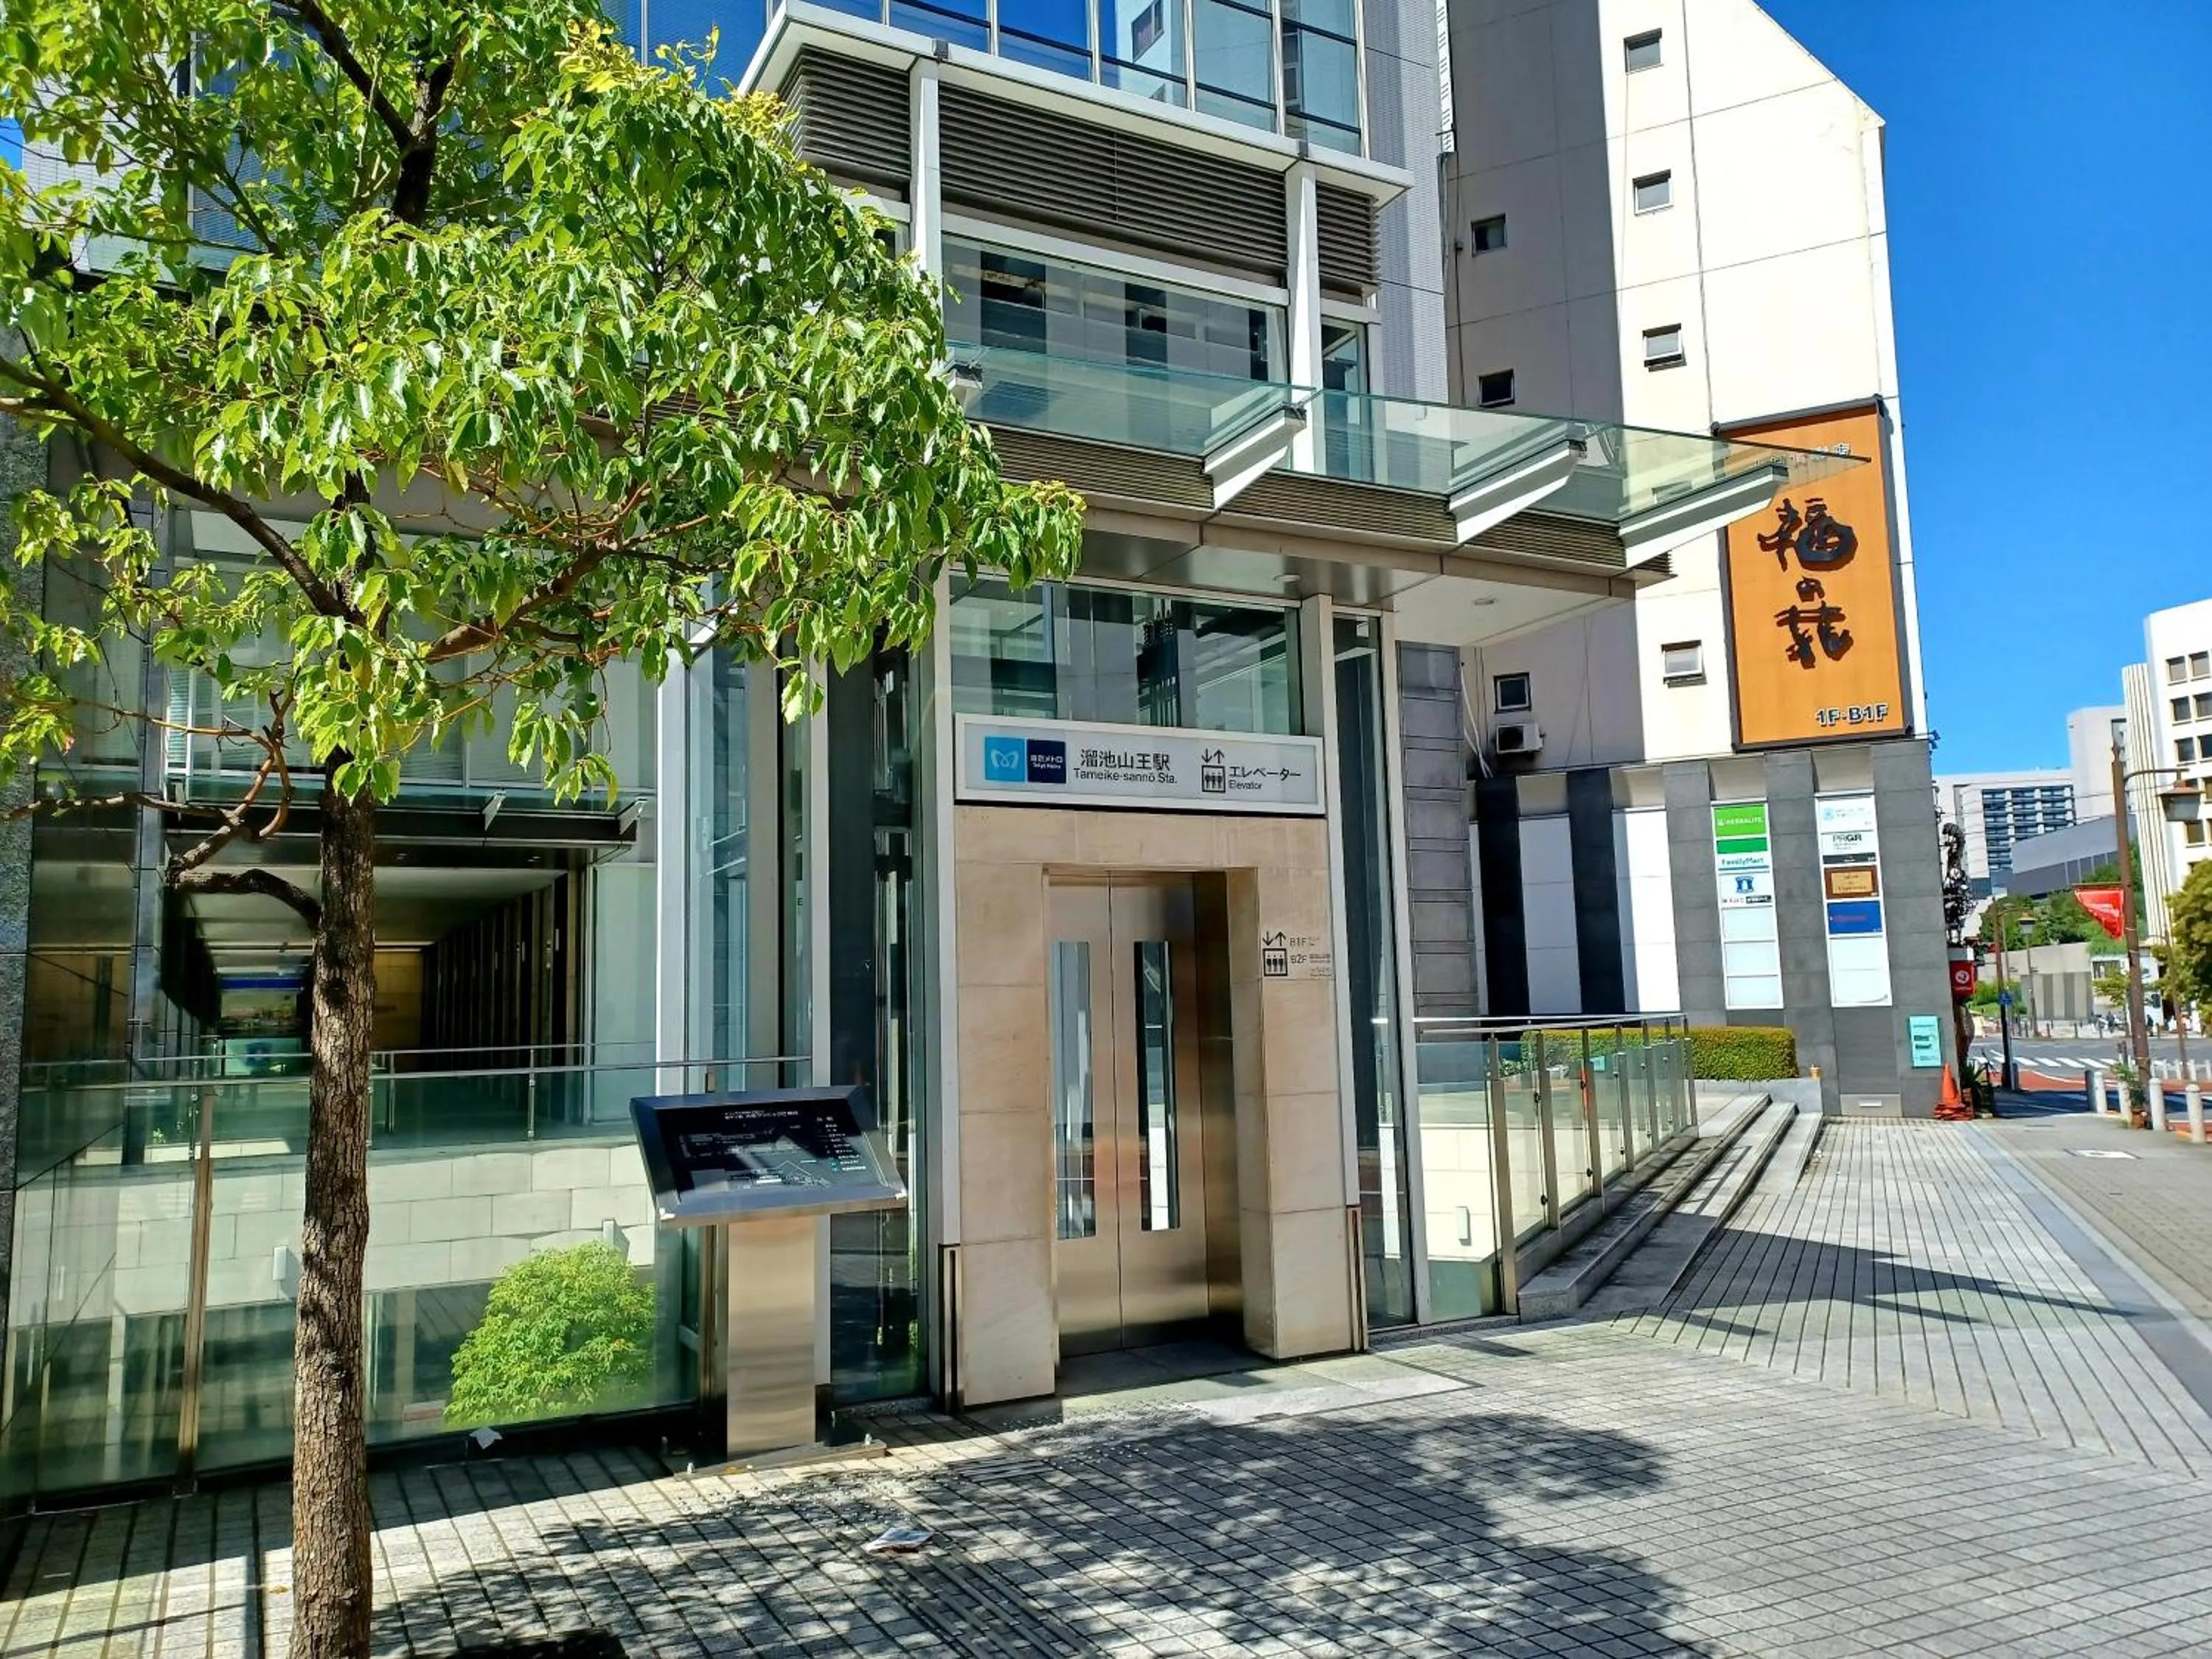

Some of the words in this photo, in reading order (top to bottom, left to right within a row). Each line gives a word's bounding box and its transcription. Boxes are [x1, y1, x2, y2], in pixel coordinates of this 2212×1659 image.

[1080, 748, 1171, 771] 溜池山王駅
[1158, 773, 1178, 784] Sta.
[1228, 766, 1301, 781] エレベーター
[1228, 780, 1263, 790] Elevator
[1722, 857, 1764, 866] FamilyMart
